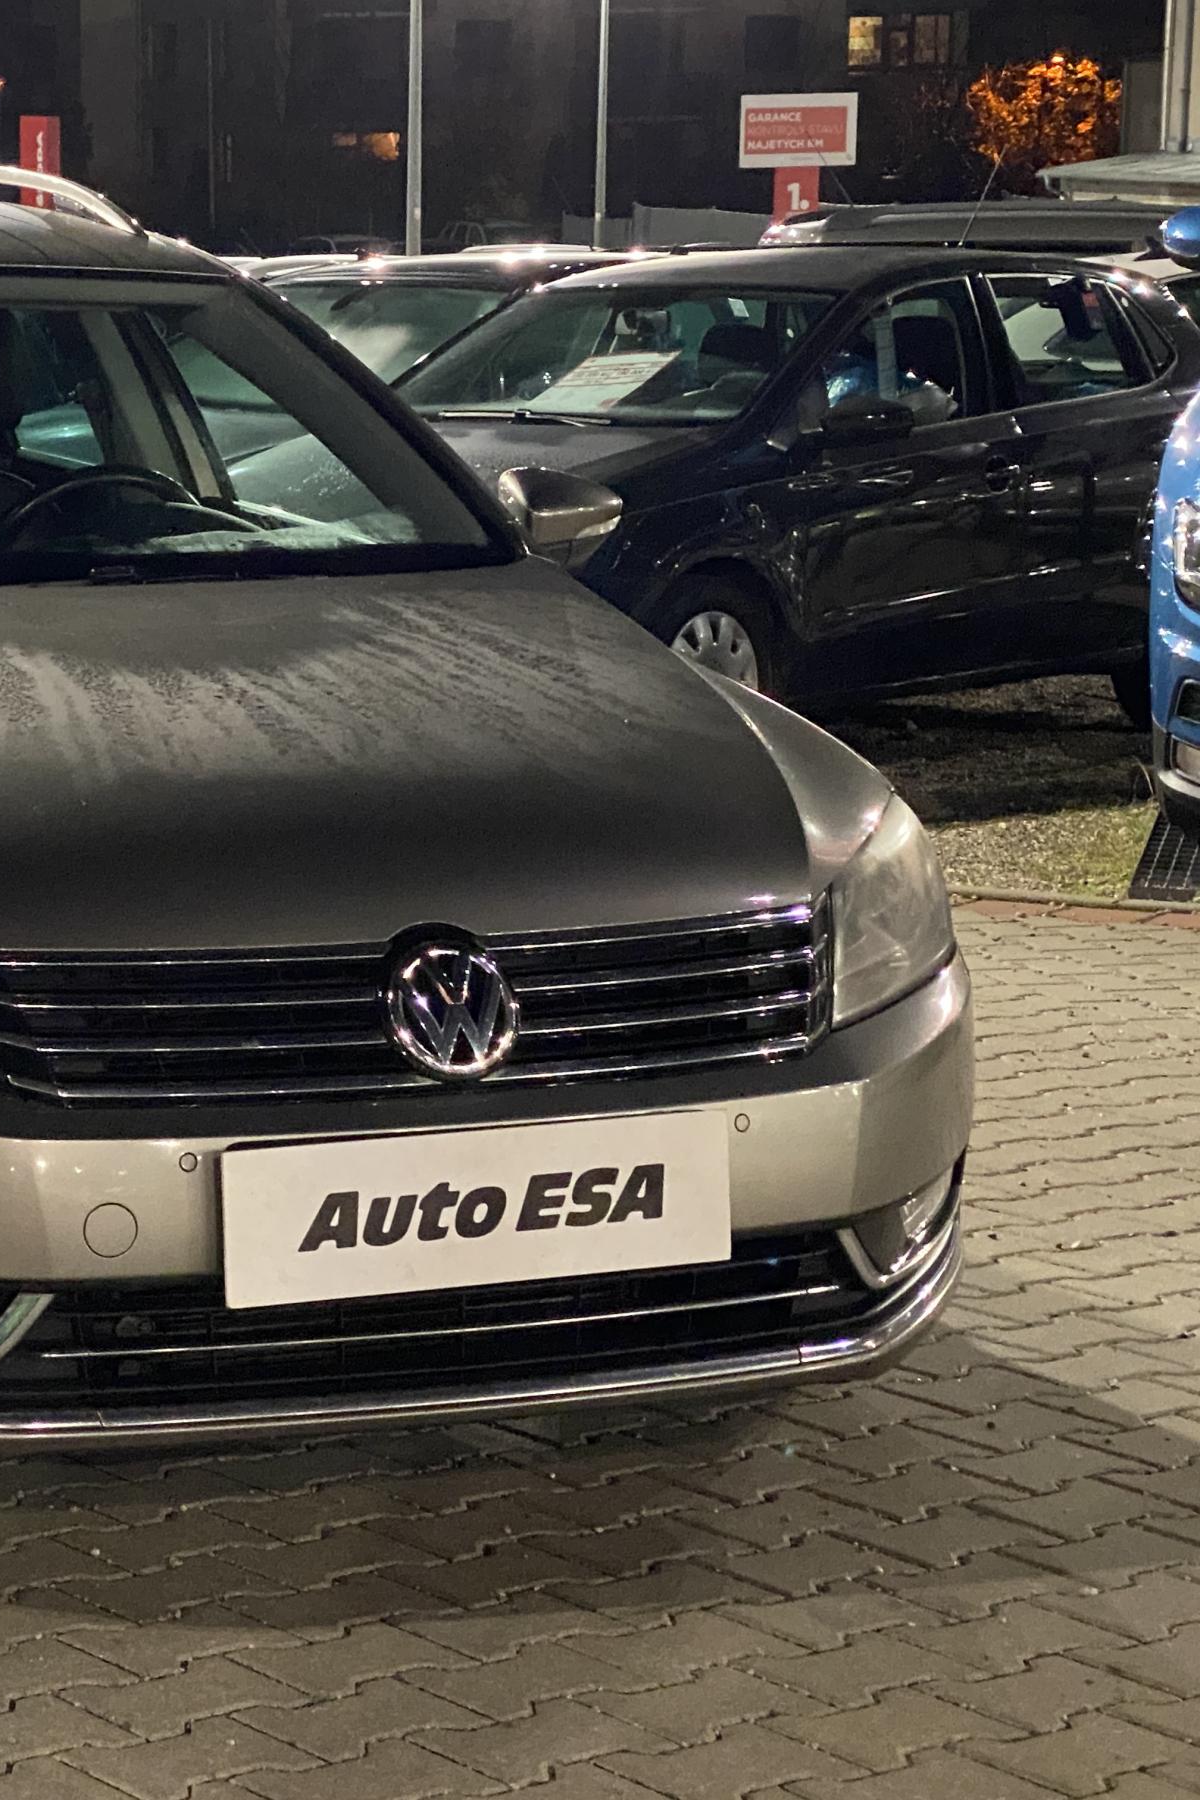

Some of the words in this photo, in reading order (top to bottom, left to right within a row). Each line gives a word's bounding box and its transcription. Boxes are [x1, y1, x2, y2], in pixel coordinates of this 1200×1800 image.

[748, 111, 802, 122] GARANCE
[787, 182, 810, 211] 1.
[297, 1181, 508, 1253] Auto
[514, 1162, 665, 1233] ESA
